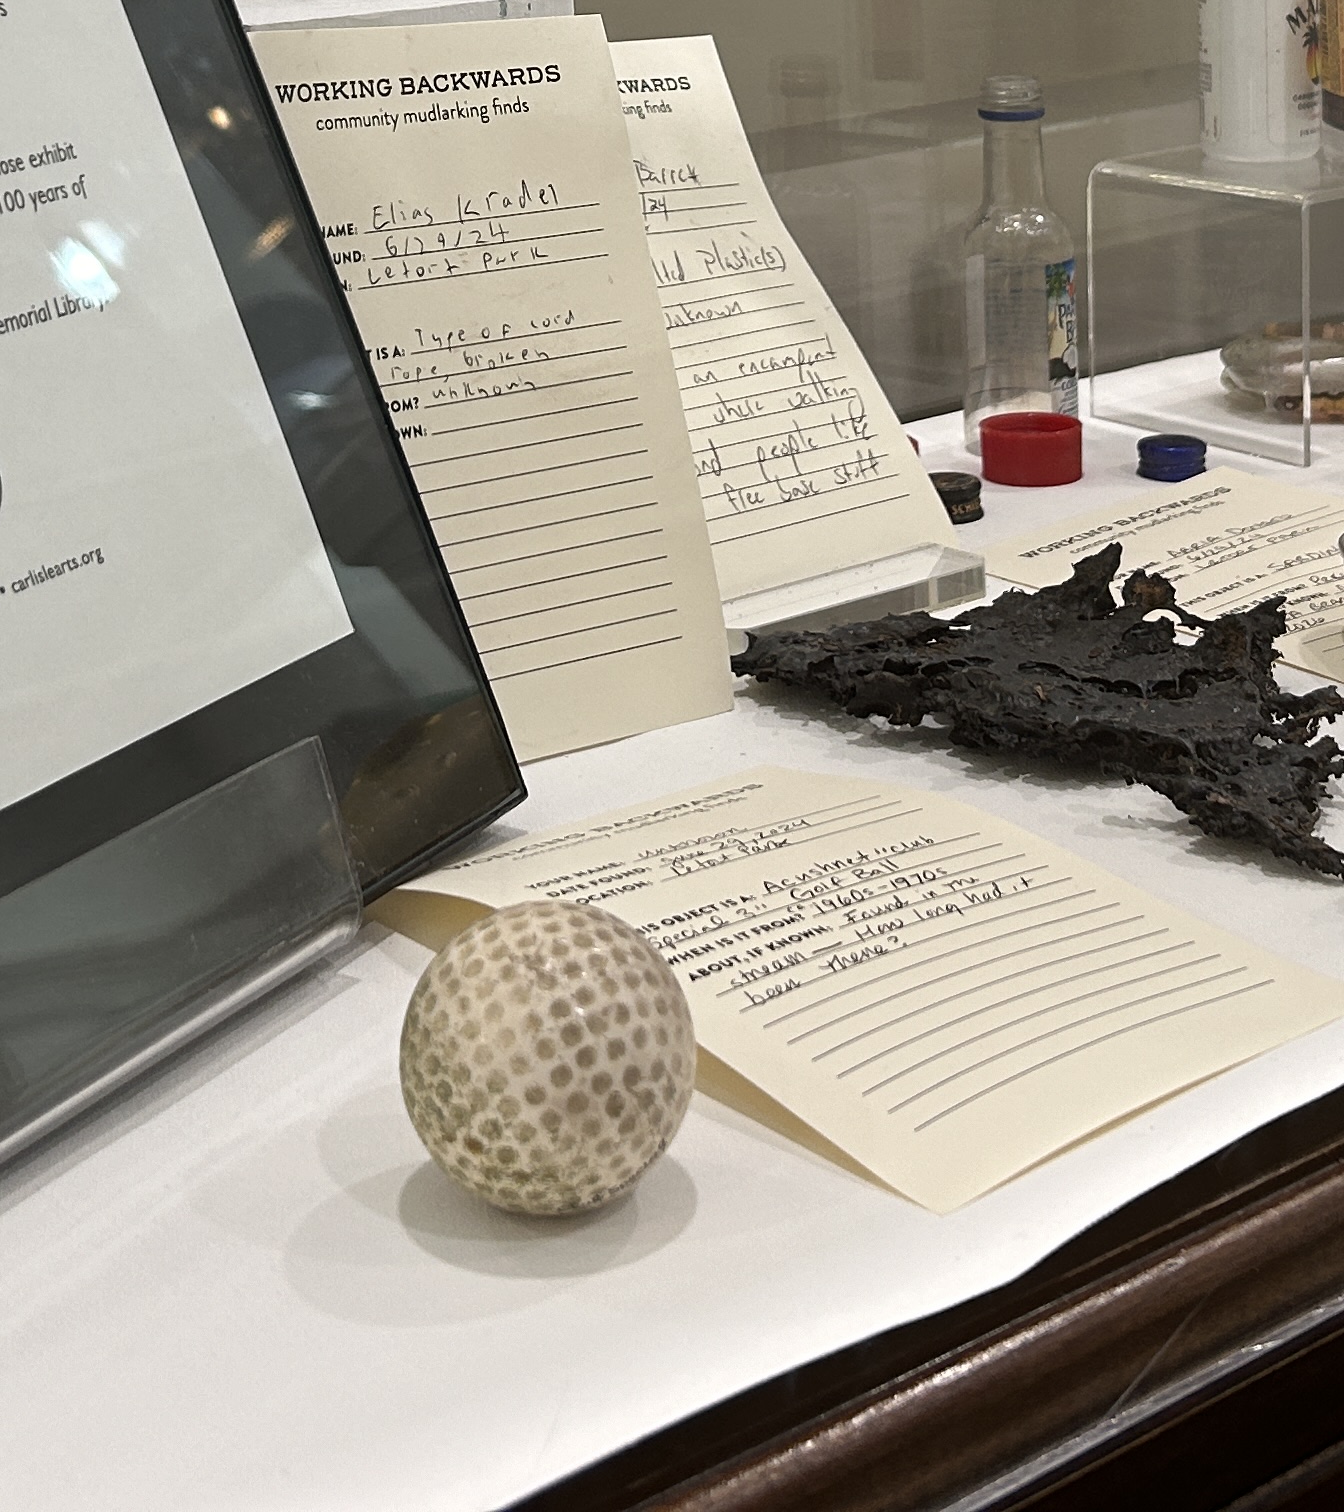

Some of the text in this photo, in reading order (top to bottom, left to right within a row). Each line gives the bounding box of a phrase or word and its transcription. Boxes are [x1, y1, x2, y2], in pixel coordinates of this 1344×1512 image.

[275, 65, 561, 104] WORKING BACKWARDS
[316, 96, 529, 132] community mudlarking finds
[644, 100, 672, 114] finds
[28, 142, 78, 168] exhibit
[372, 200, 434, 230] Elias
[377, 347, 406, 360] IS A:
[415, 328, 466, 351] Type
[11, 548, 105, 594] carlislearts.org
[661, 902, 719, 927] OBJECT
[668, 912, 806, 965] WHEN IS IT FROM?
[688, 926, 833, 981] ABOUT, IF KNOWN:
